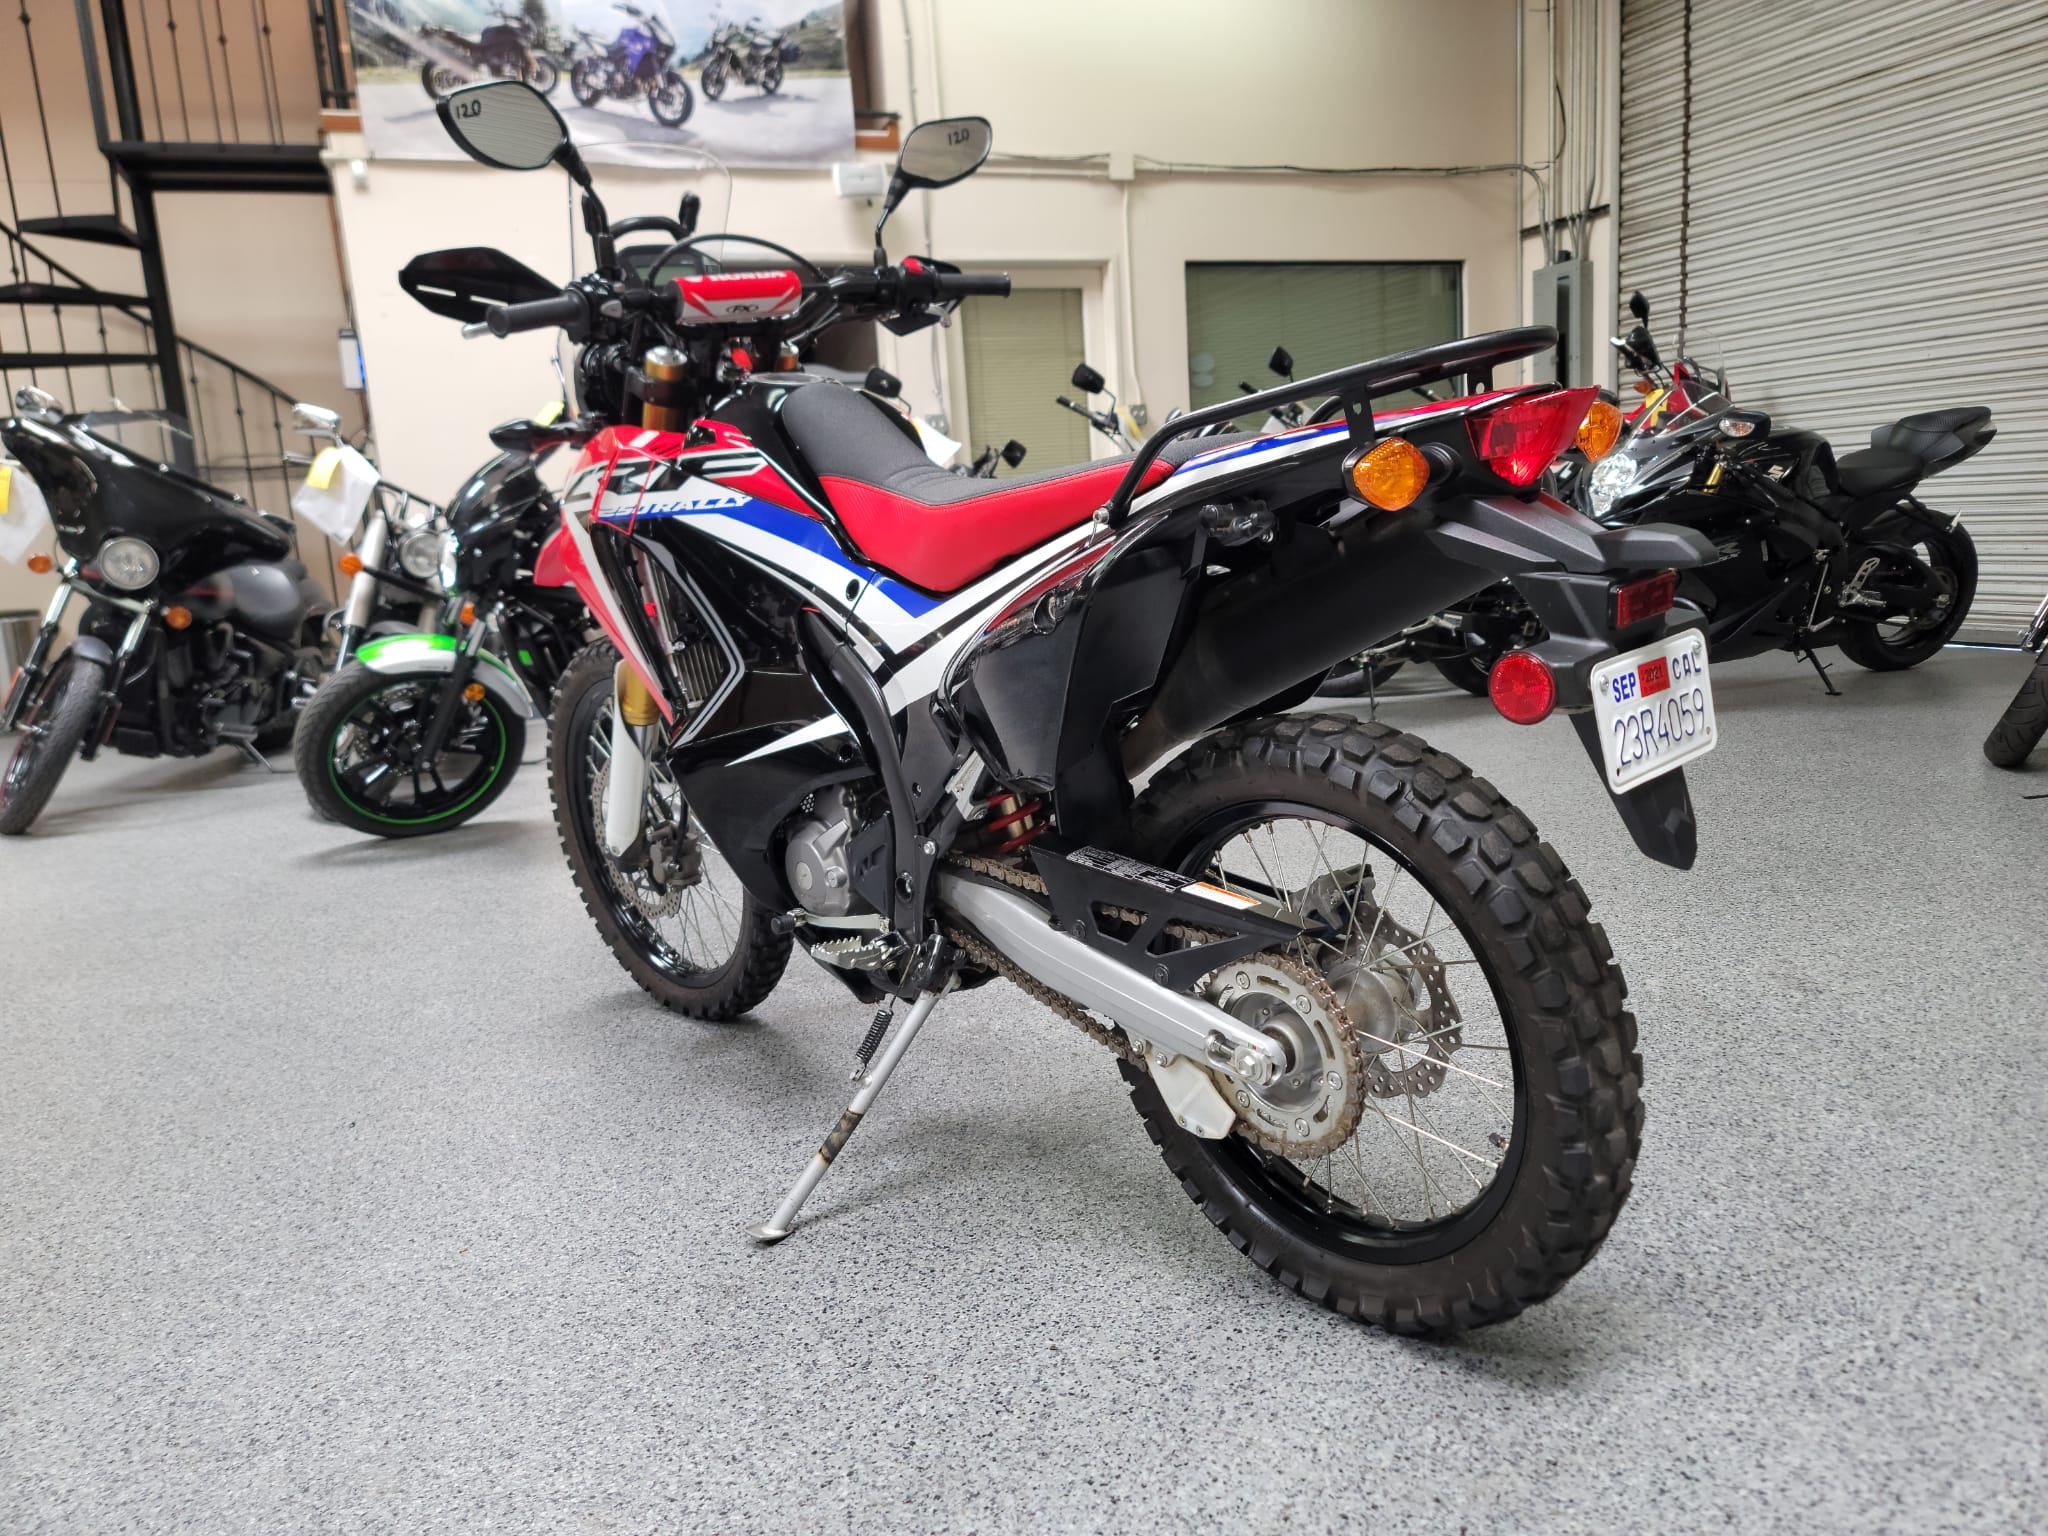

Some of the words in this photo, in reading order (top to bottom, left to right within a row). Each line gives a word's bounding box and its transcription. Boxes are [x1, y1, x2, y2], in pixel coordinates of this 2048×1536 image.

[456, 99, 481, 119] 120
[948, 128, 970, 146] 120
[648, 495, 753, 514] RALLY
[1612, 671, 1637, 703] SEP
[1644, 665, 1664, 683] 2021
[1672, 651, 1702, 680] CAL
[1614, 688, 1705, 766] 23R4059
